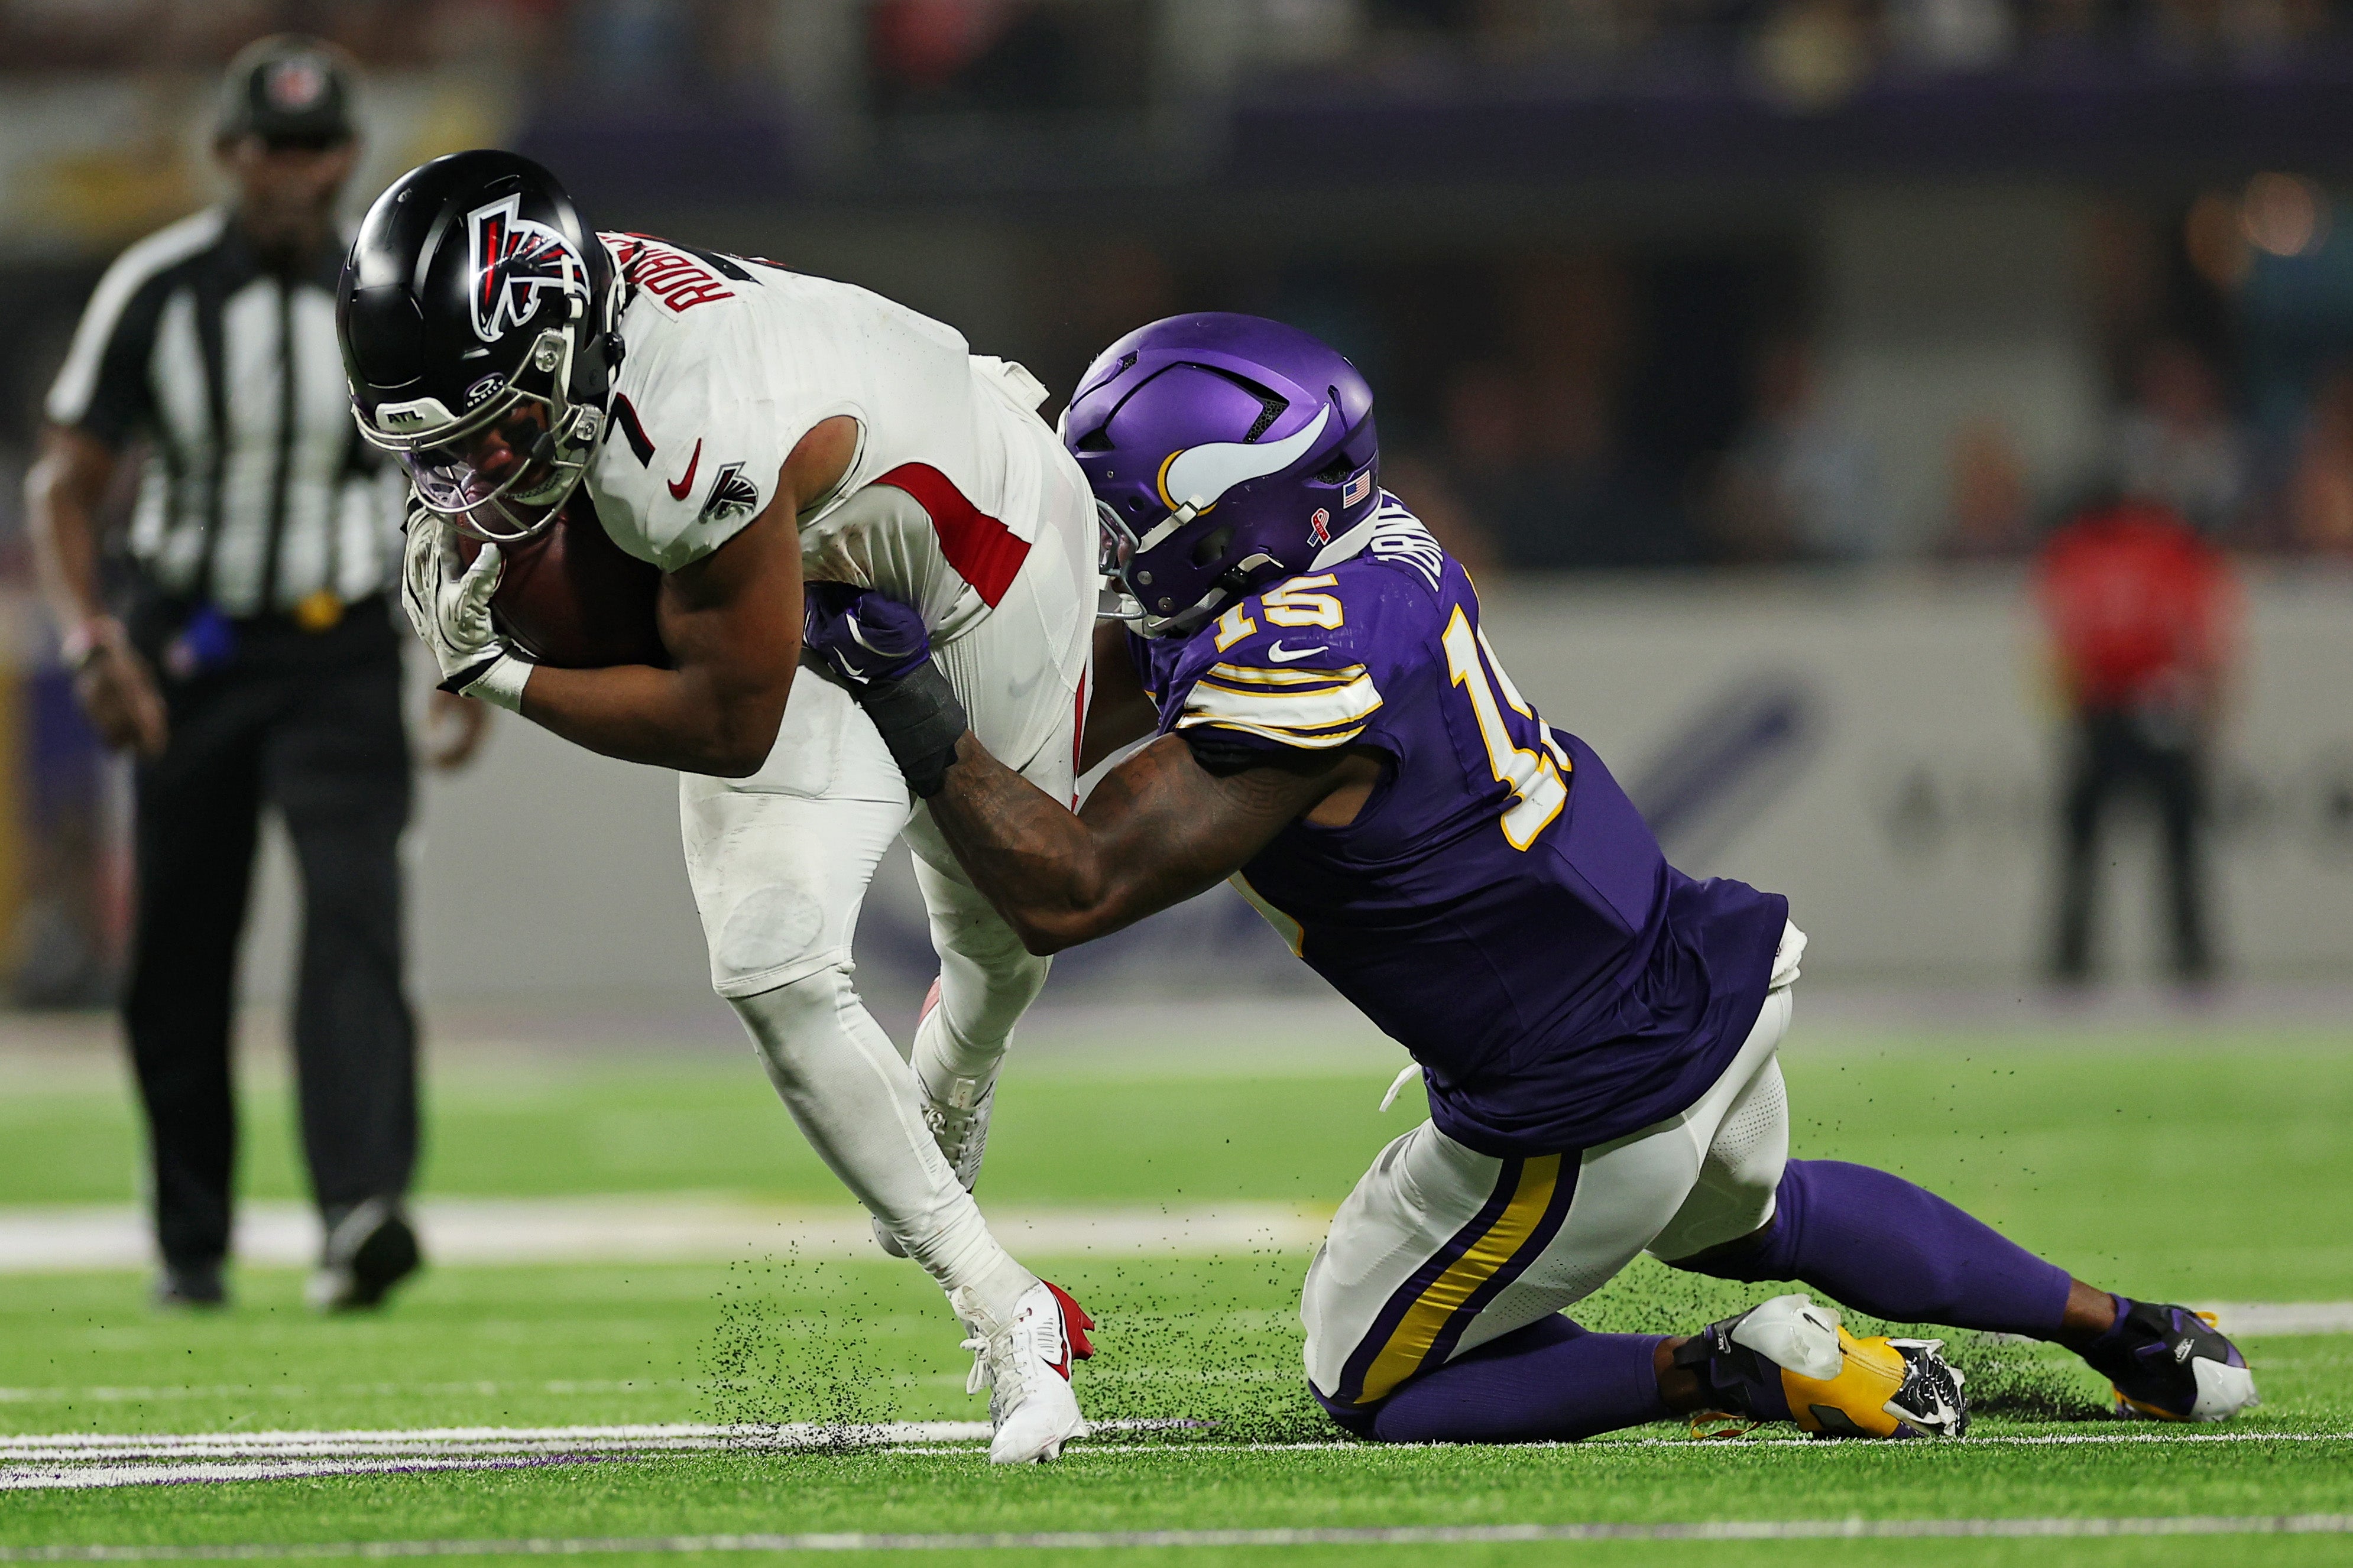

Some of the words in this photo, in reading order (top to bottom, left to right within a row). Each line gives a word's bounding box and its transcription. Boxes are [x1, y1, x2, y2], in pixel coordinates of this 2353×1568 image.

[385, 408, 424, 424] ATL
[602, 392, 656, 469] 7
[1214, 573, 1343, 652] 15
